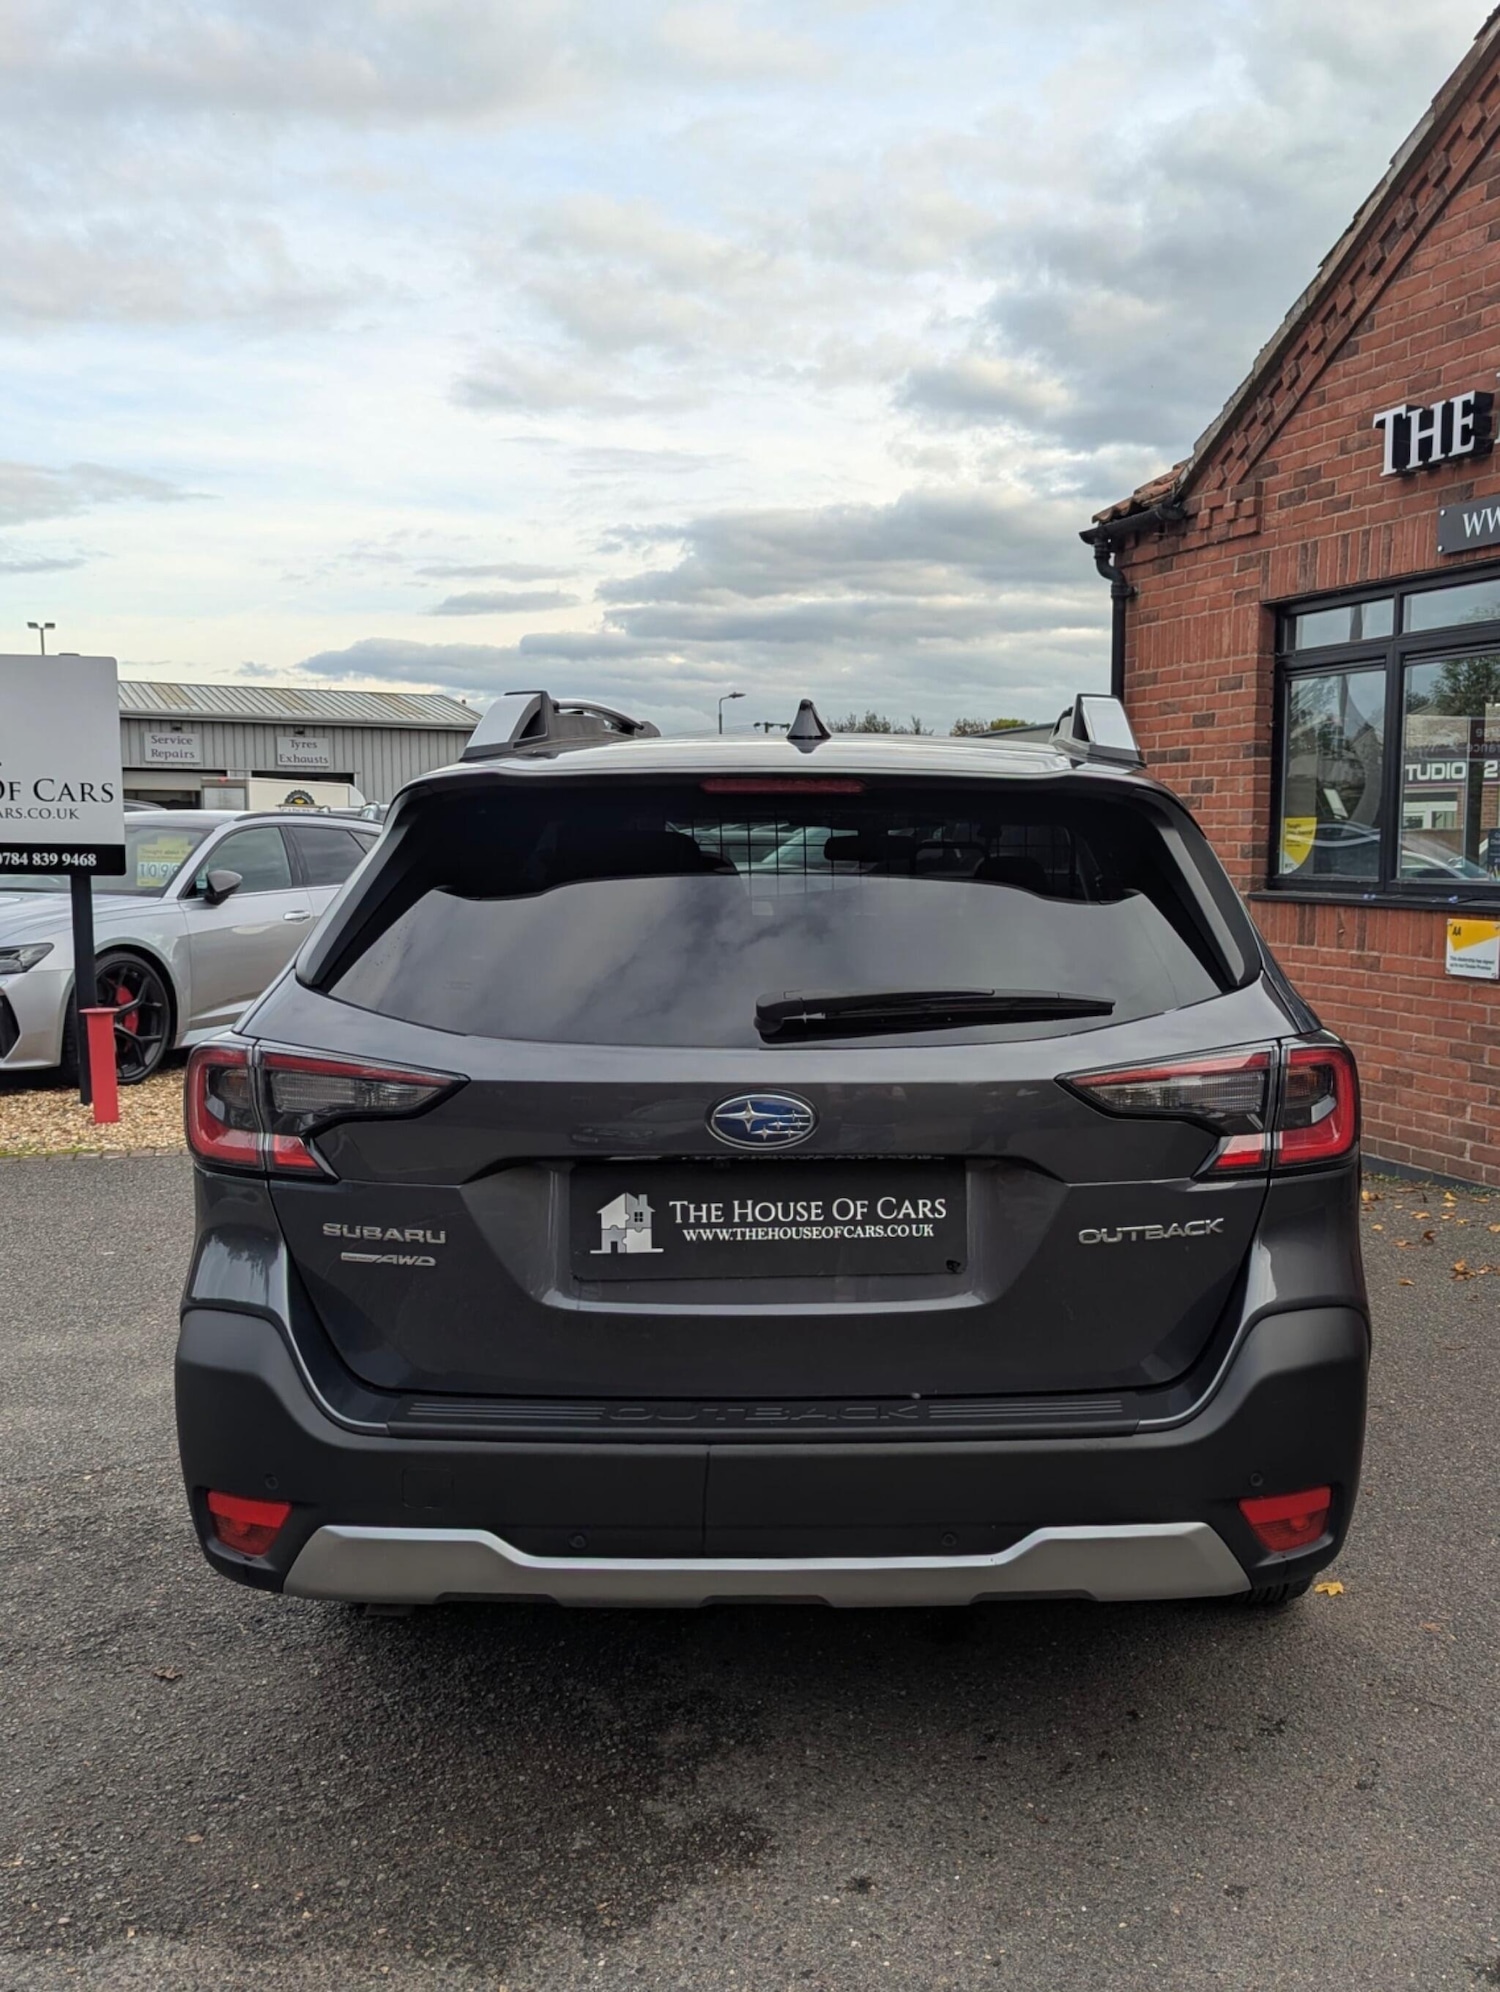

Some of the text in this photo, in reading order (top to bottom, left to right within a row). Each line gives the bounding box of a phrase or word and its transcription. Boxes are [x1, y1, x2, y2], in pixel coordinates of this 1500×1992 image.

[1372, 390, 1476, 477] THE
[151, 735, 193, 746] Service
[289, 739, 318, 751] Tyres
[150, 749, 195, 761] Repairs
[279, 754, 329, 765] Exhausts
[0, 777, 115, 804] F CARS
[32, 852, 59, 867] 839
[62, 852, 97, 867] 9468
[1452, 926, 1462, 937] AA
[669, 1196, 947, 1224] THE HOUSE OF CARS
[322, 1222, 447, 1244] SUBARU
[1078, 1217, 1224, 1244] OUTBACK
[376, 1254, 437, 1267] AWD
[609, 1403, 919, 1421] OUTBACK
